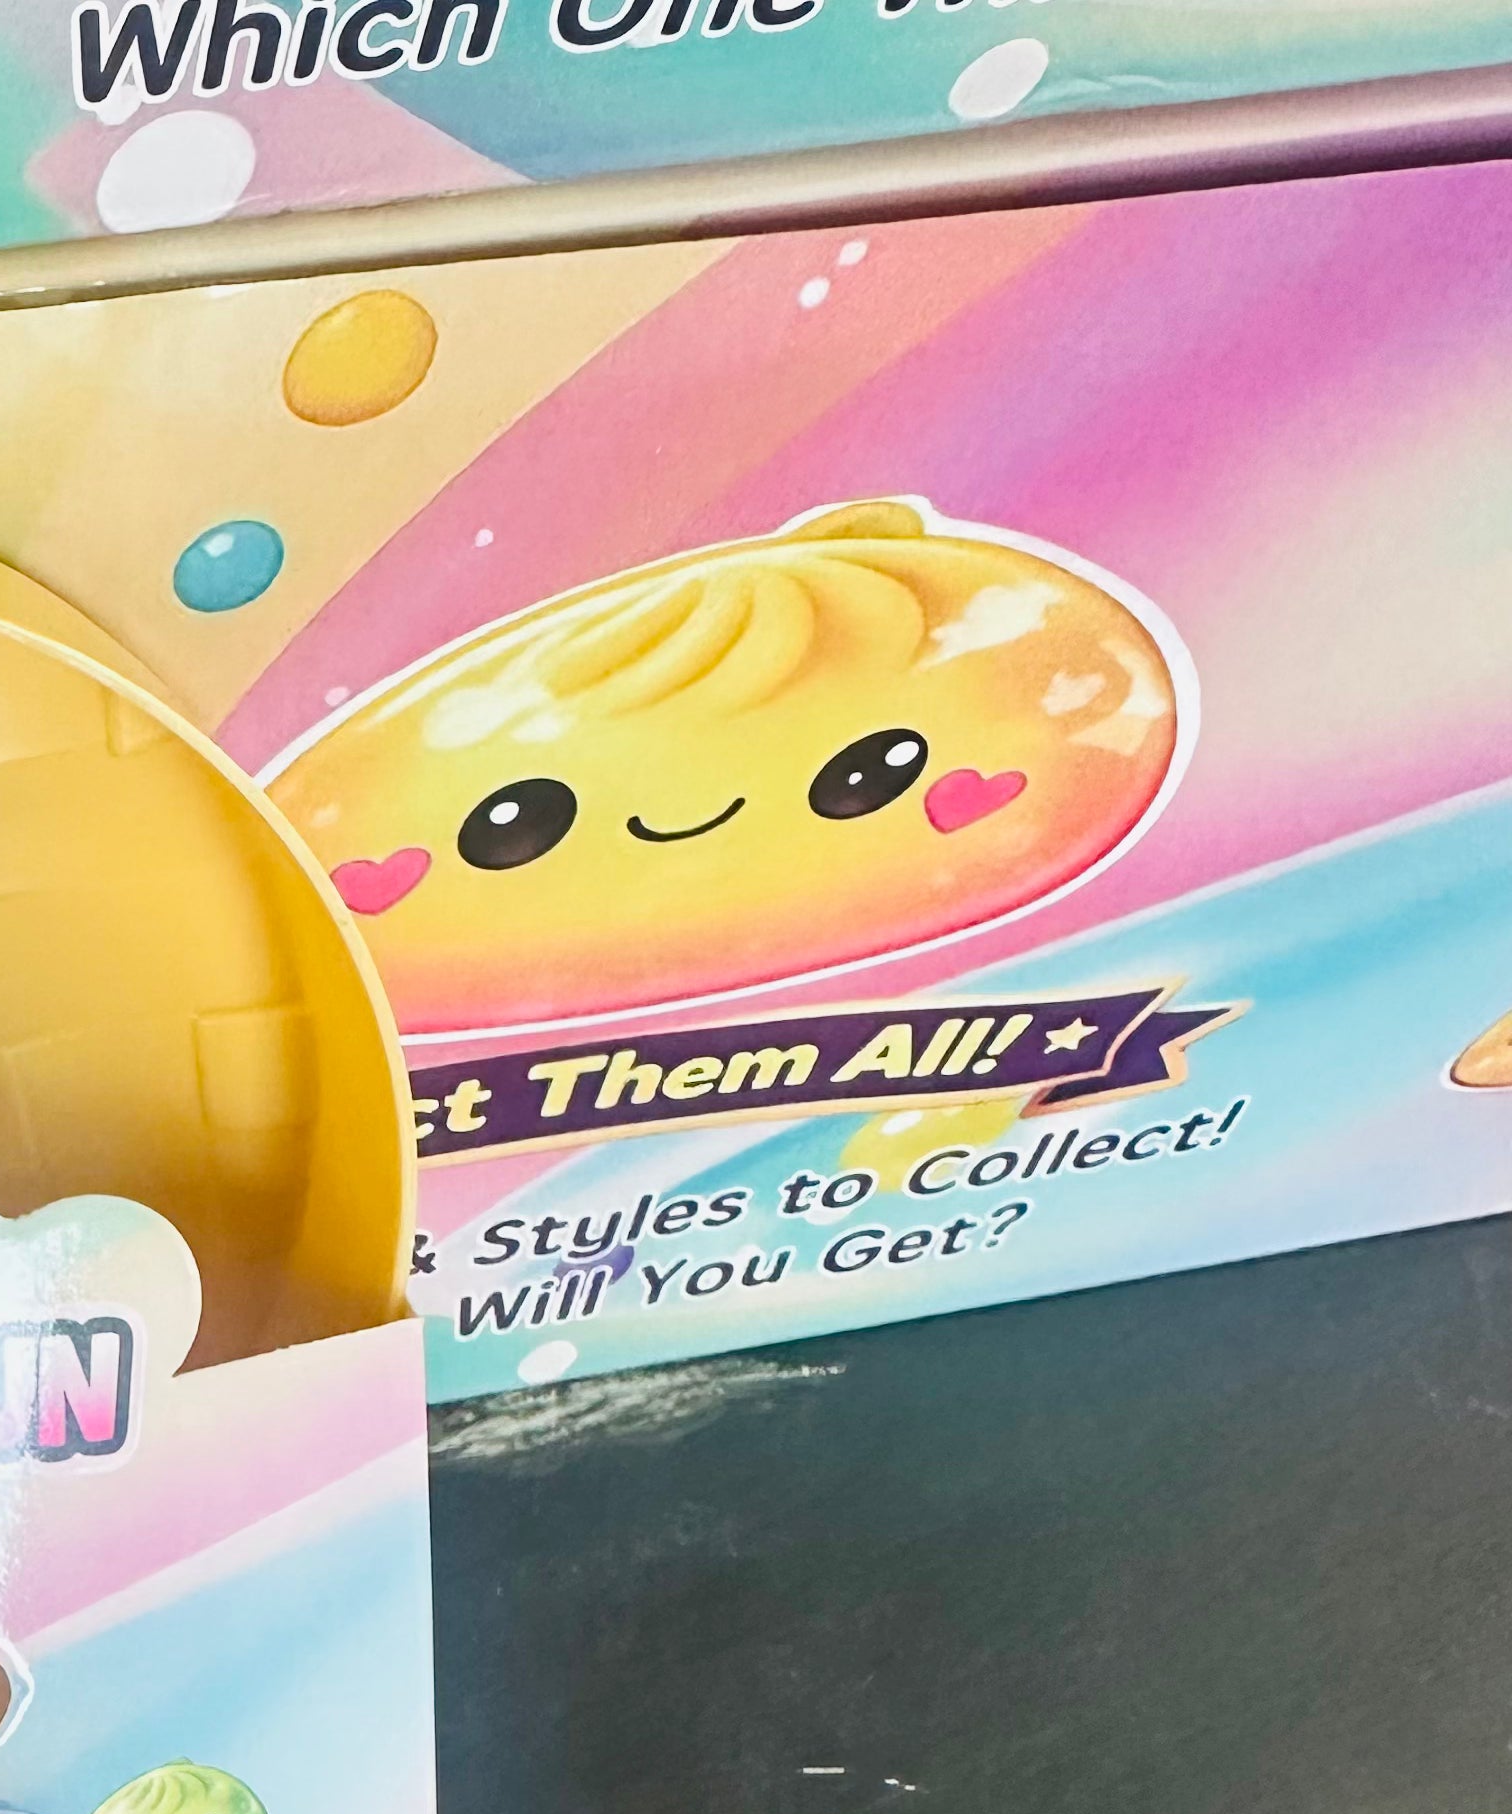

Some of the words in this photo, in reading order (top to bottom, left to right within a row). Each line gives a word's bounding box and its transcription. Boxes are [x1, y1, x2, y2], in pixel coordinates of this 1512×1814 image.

[528, 1043, 818, 1118] Them
[830, 1013, 1034, 1084] All!
[473, 1193, 748, 1266] Styles
[781, 1172, 875, 1214] to
[907, 1099, 1246, 1196] Collect!
[458, 1269, 607, 1337] Will
[640, 1249, 790, 1305] You
[822, 1201, 1028, 1274] Get?
